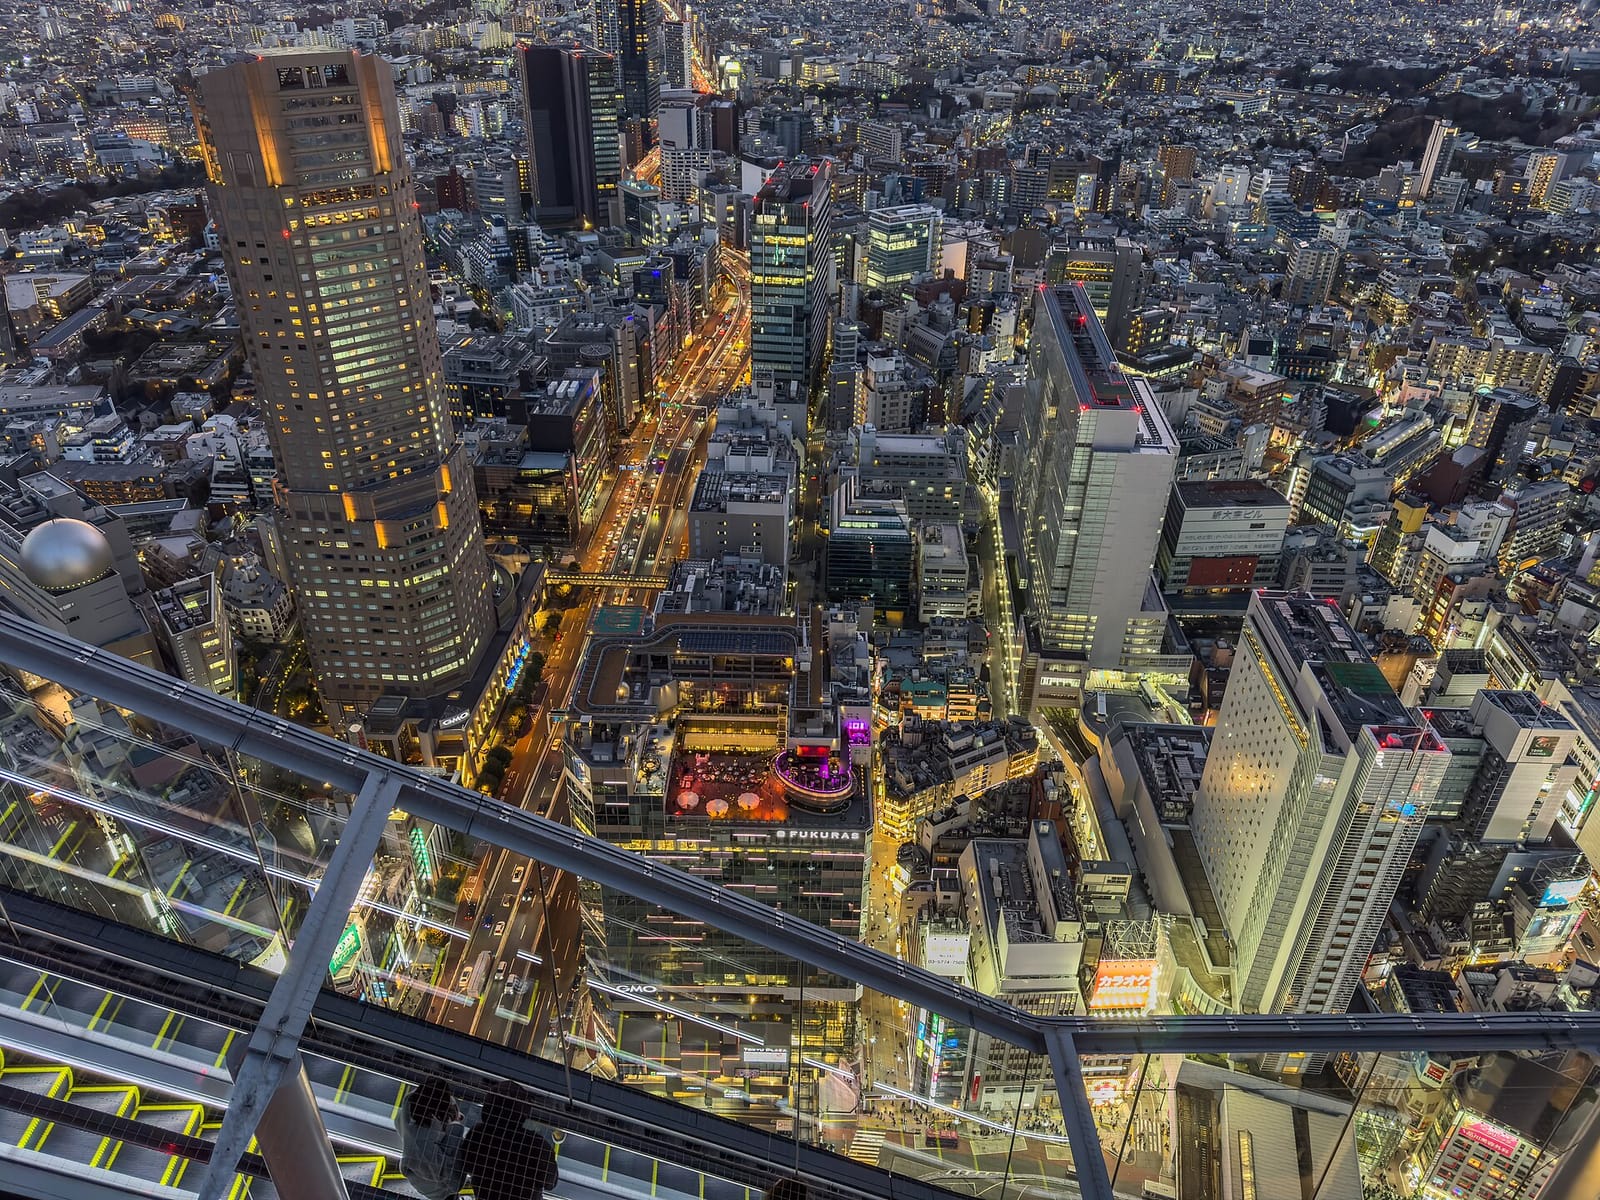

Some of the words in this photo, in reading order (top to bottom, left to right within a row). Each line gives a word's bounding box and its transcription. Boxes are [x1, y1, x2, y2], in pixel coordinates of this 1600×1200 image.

[789, 830, 860, 840] FUKURAS
[1098, 974, 1150, 987] カラオケ
[616, 985, 657, 993] GMO
